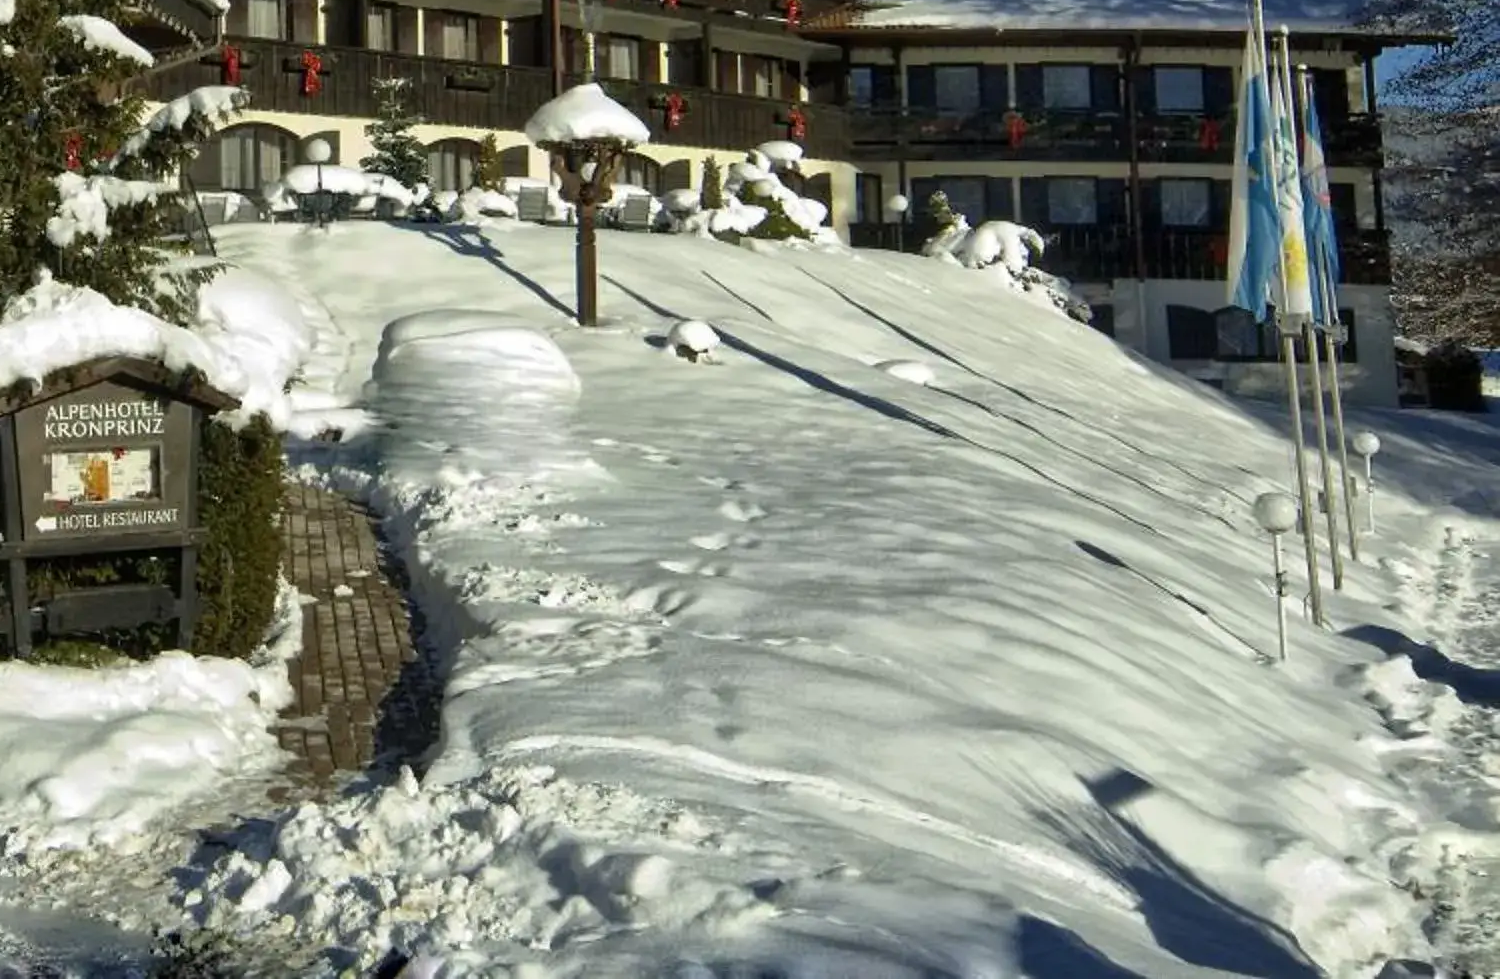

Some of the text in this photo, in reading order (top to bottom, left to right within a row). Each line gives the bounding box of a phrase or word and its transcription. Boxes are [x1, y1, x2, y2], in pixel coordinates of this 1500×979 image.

[45, 400, 165, 422] ALPENHOTEL
[44, 418, 165, 439] KRONPRINZ
[59, 508, 178, 529] HOTEL RESTAURANT
